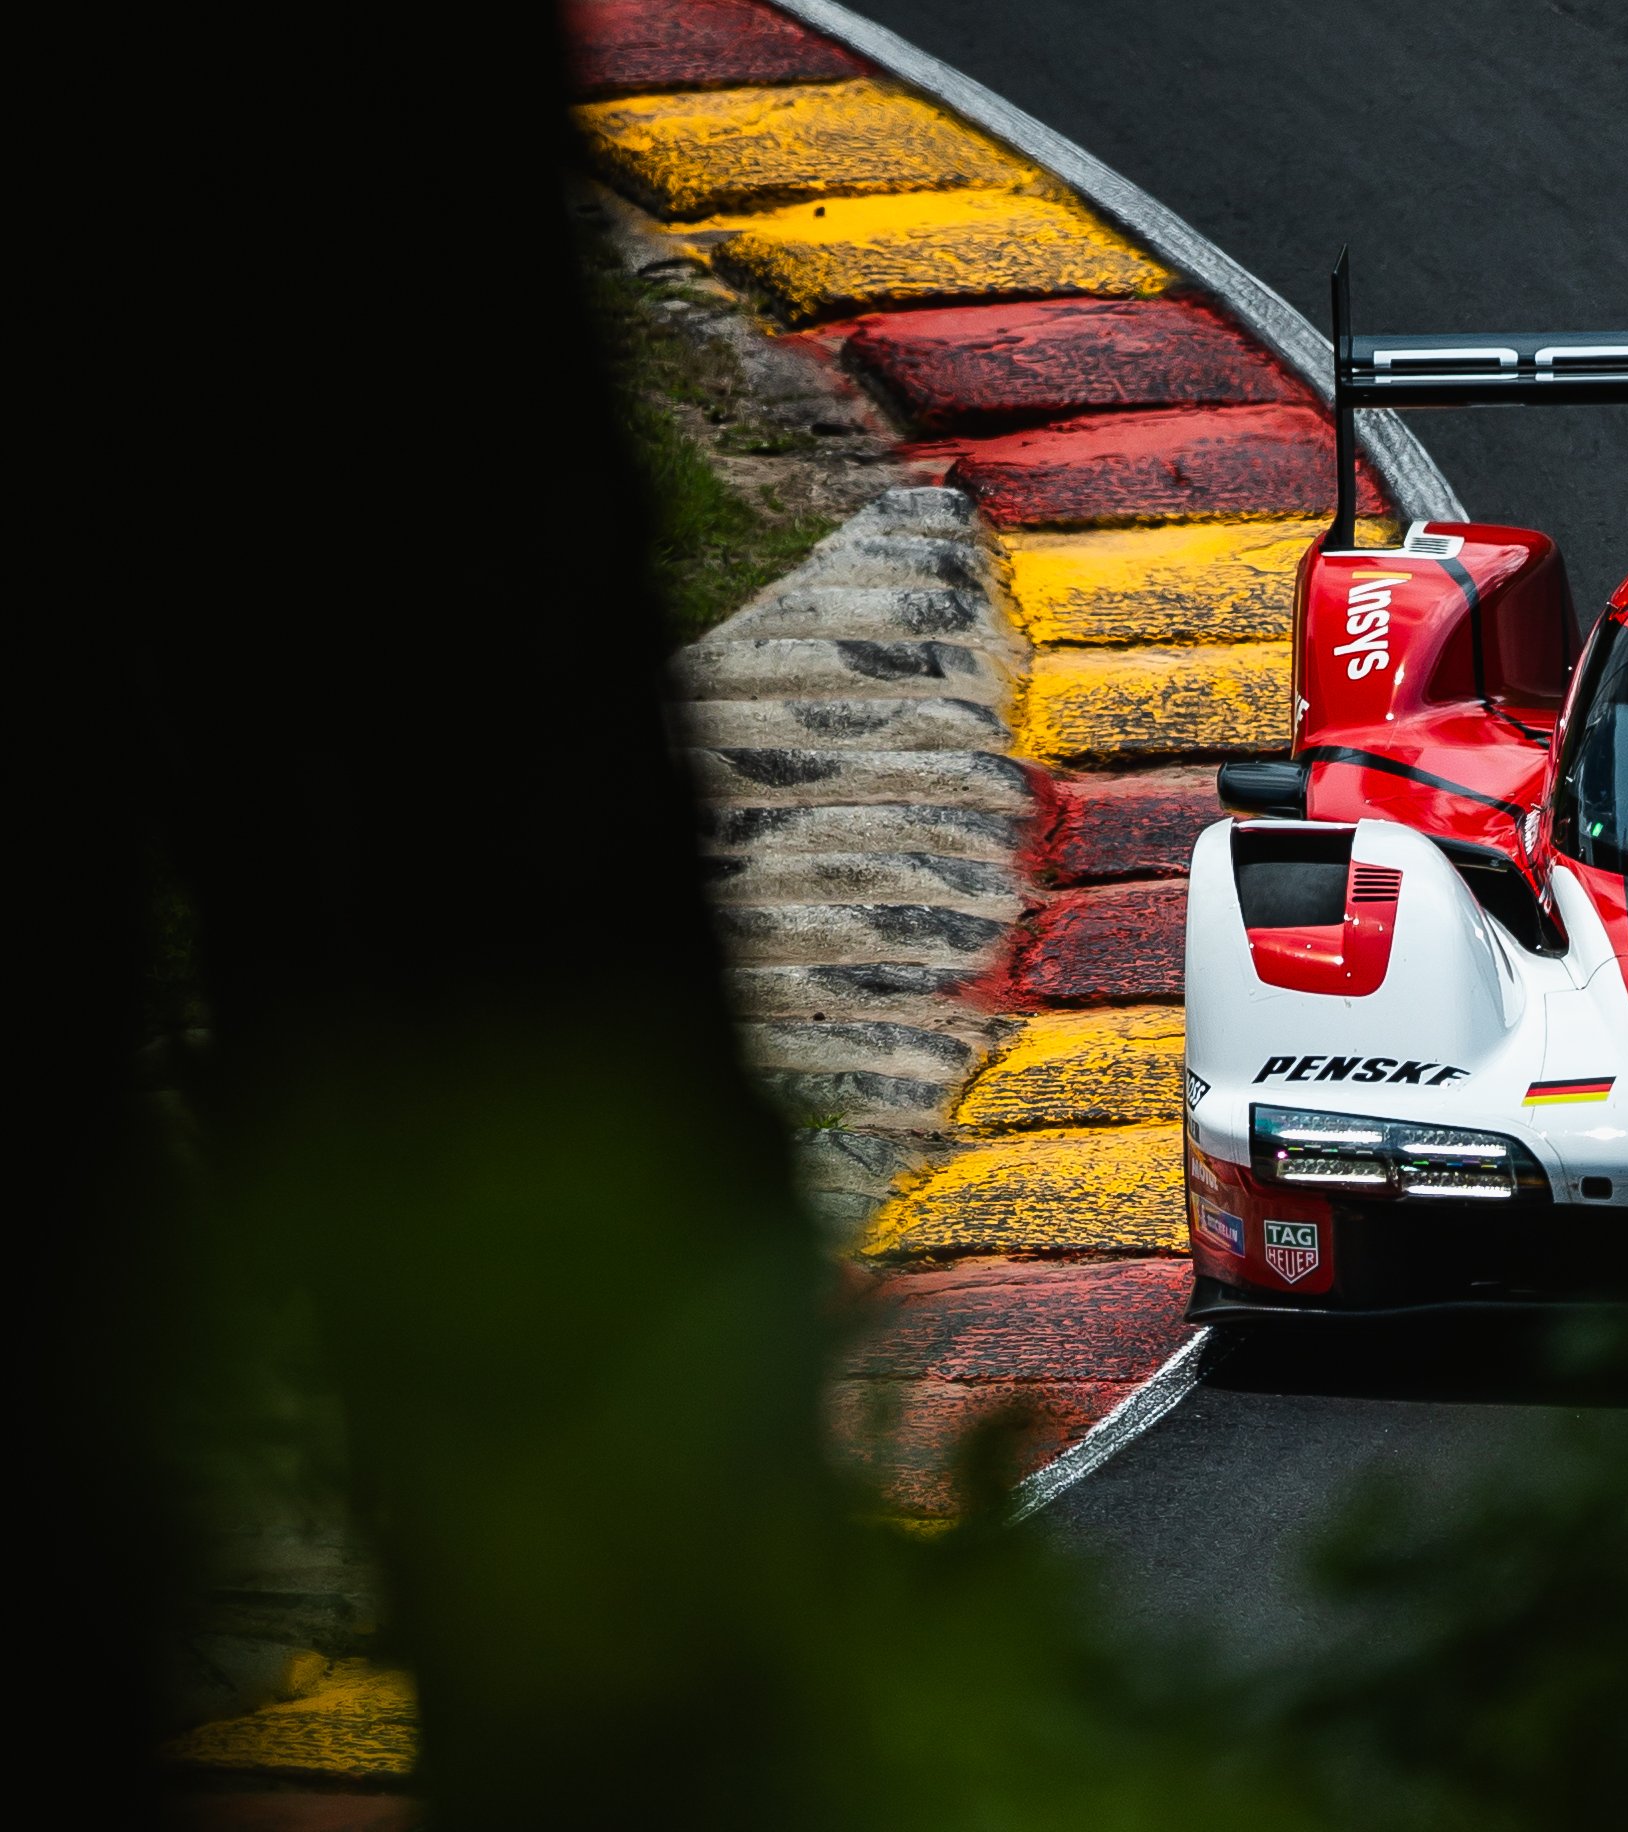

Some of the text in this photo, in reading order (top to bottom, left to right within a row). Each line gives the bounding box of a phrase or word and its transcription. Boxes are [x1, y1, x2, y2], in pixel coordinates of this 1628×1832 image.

[1333, 571, 1412, 680] Ansys
[1251, 1055, 1472, 1087] PENSKE
[1268, 1225, 1312, 1246] TAG
[1268, 1248, 1315, 1278] HEUER
